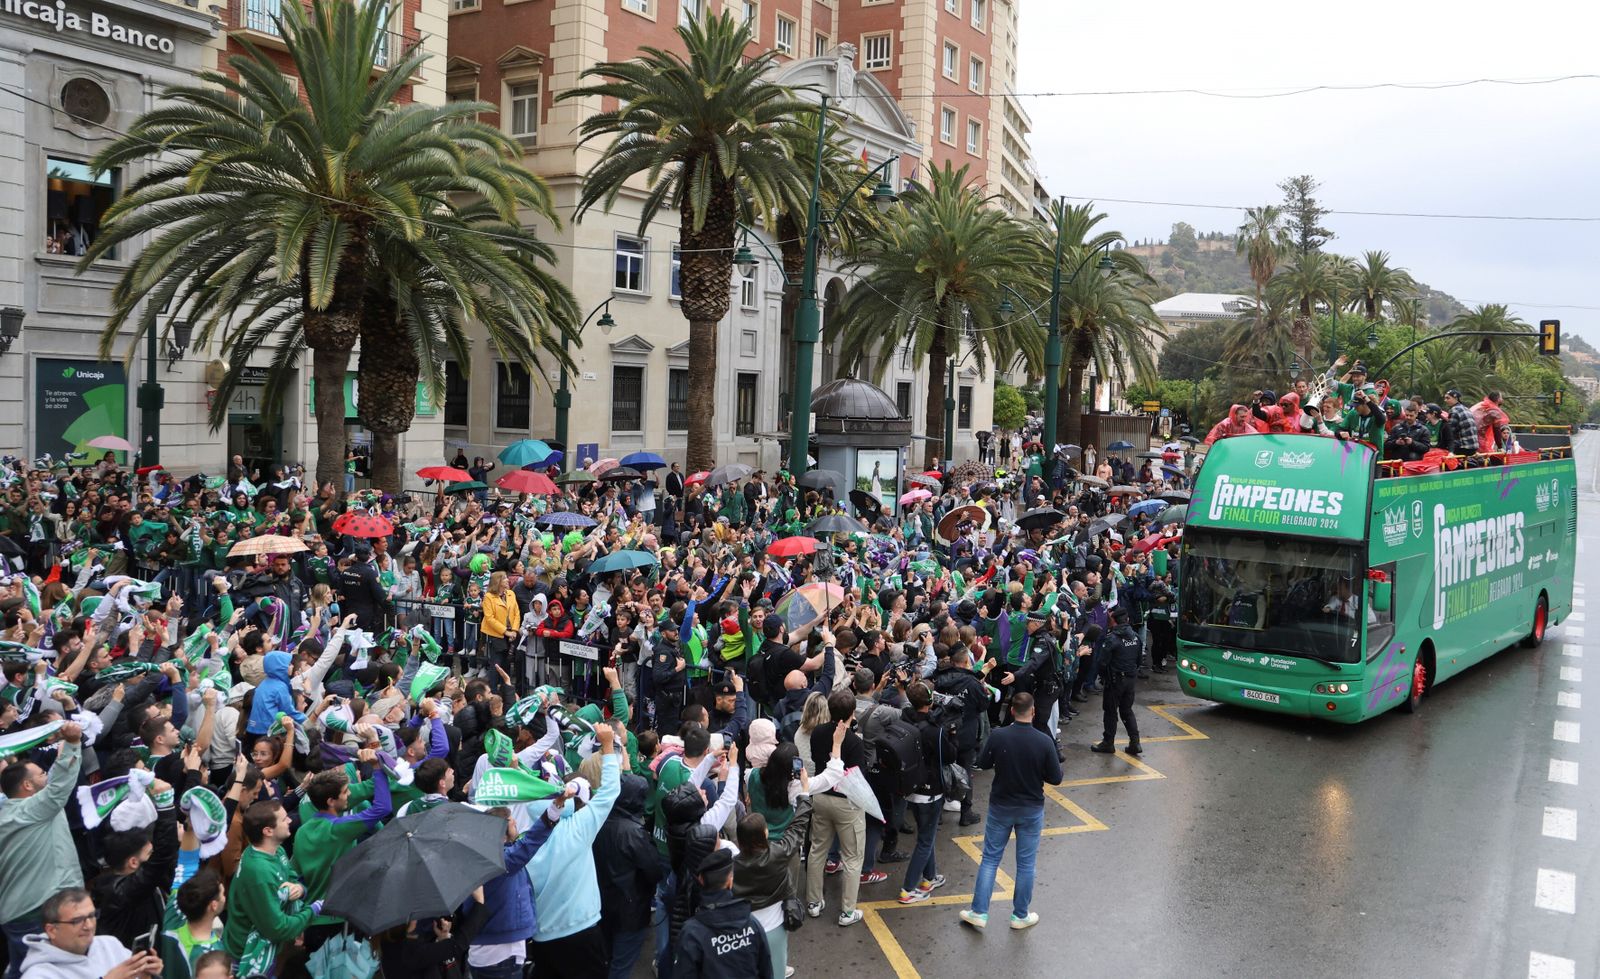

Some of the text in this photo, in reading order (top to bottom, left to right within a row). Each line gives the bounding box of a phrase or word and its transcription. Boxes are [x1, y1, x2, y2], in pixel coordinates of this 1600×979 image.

[91, 12, 175, 54] Banco
[76, 371, 105, 380] Unicaja
[228, 389, 257, 411] 4h
[1208, 474, 1344, 521] CAMPEONES
[1222, 507, 1339, 529] FINAL FOUR BELGRADO 2024
[1433, 503, 1525, 630] CAMPEONES
[1351, 638, 1357, 647] 7
[1232, 654, 1255, 664] Unicaja
[1270, 662, 1290, 670] Unicaja
[1246, 690, 1263, 700] 8400
[716, 937, 753, 956] LOCAL
